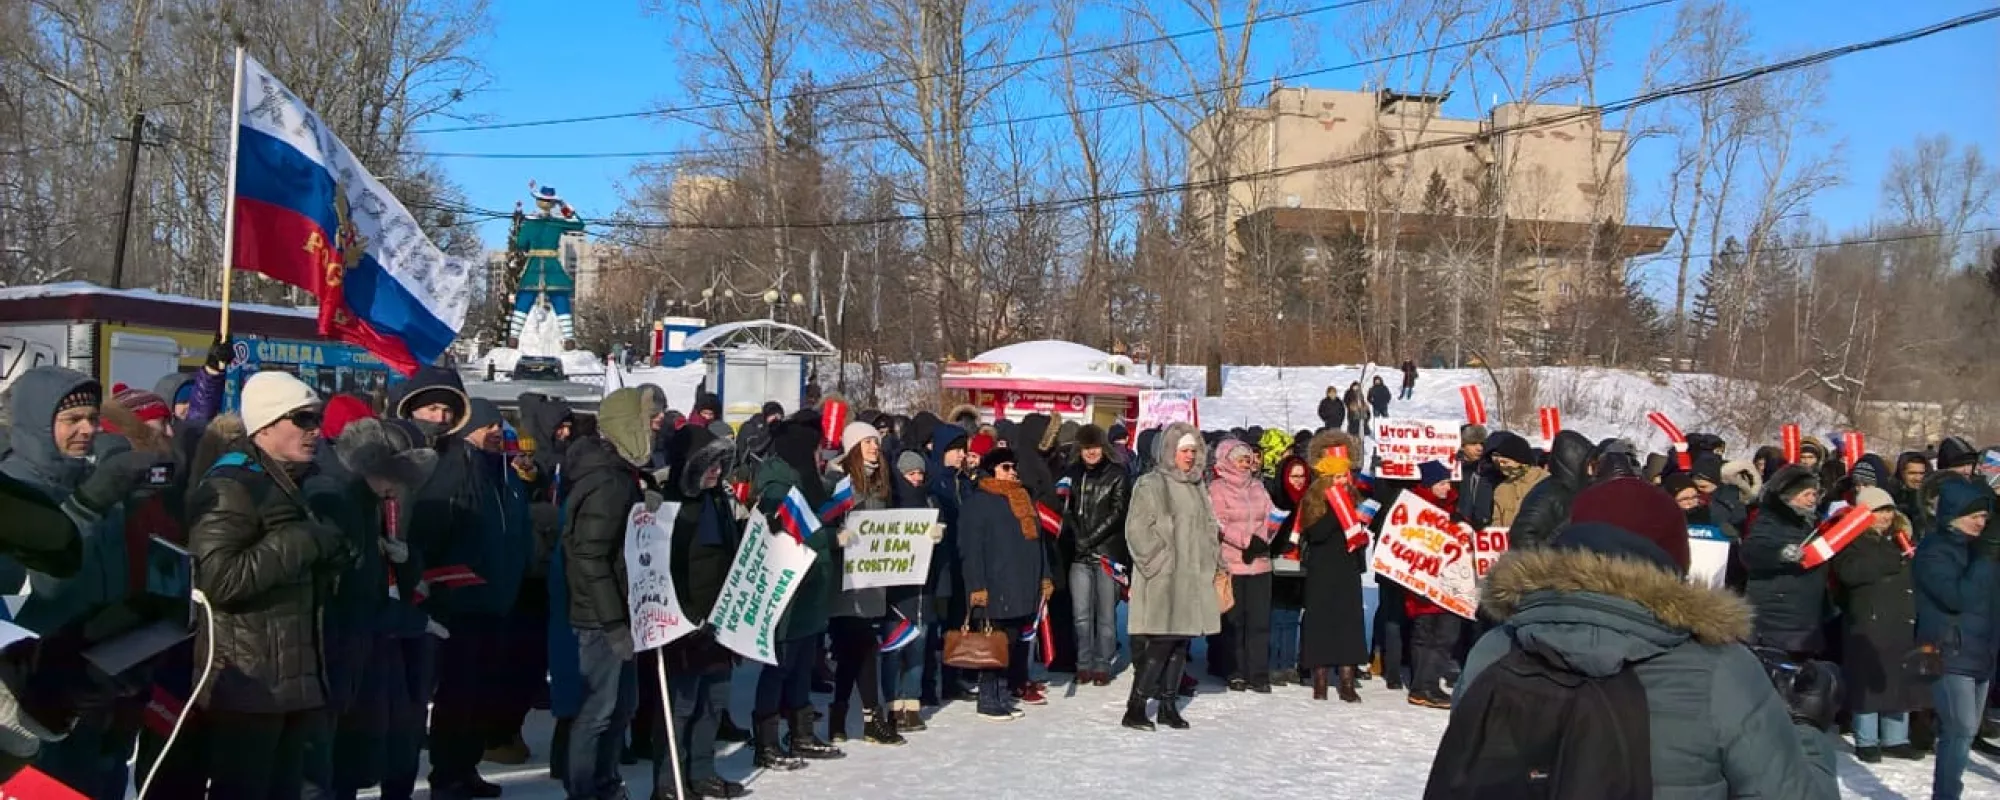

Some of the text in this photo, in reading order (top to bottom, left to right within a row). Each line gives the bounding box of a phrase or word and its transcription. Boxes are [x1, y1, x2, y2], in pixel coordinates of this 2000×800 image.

[256, 341, 324, 364] CINEMA
[1391, 503, 1409, 526] А
[887, 521, 901, 535] НЕ
[904, 521, 930, 536] ИДУ
[870, 538, 911, 553] И ВАМ
[745, 539, 769, 584] БУДЕТ
